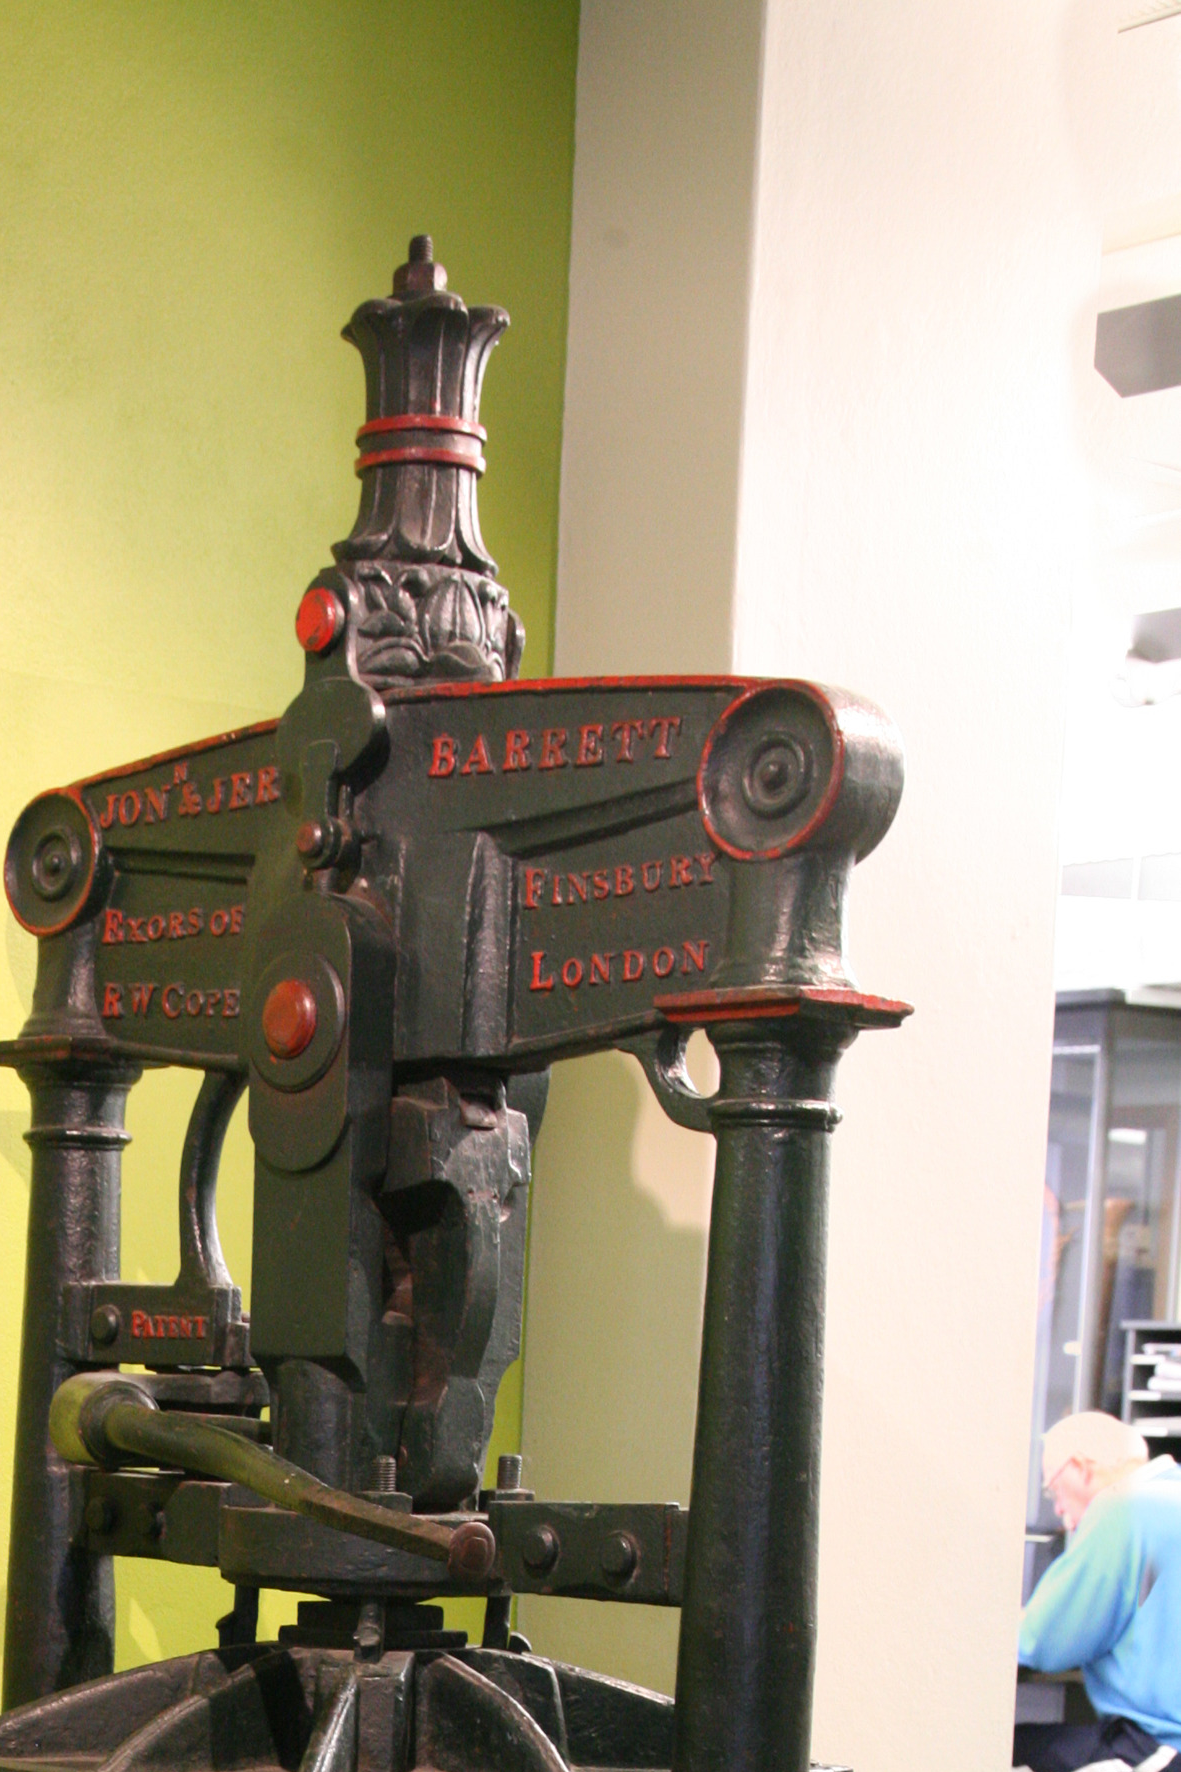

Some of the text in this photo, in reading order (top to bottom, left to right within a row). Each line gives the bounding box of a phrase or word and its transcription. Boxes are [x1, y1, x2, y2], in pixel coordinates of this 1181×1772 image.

[427, 716, 682, 778] BARRETT
[524, 852, 718, 909] FINSBURY
[529, 940, 710, 991] LONDON
[161, 981, 242, 1019] COPE
[131, 1309, 207, 1339] PATENT
